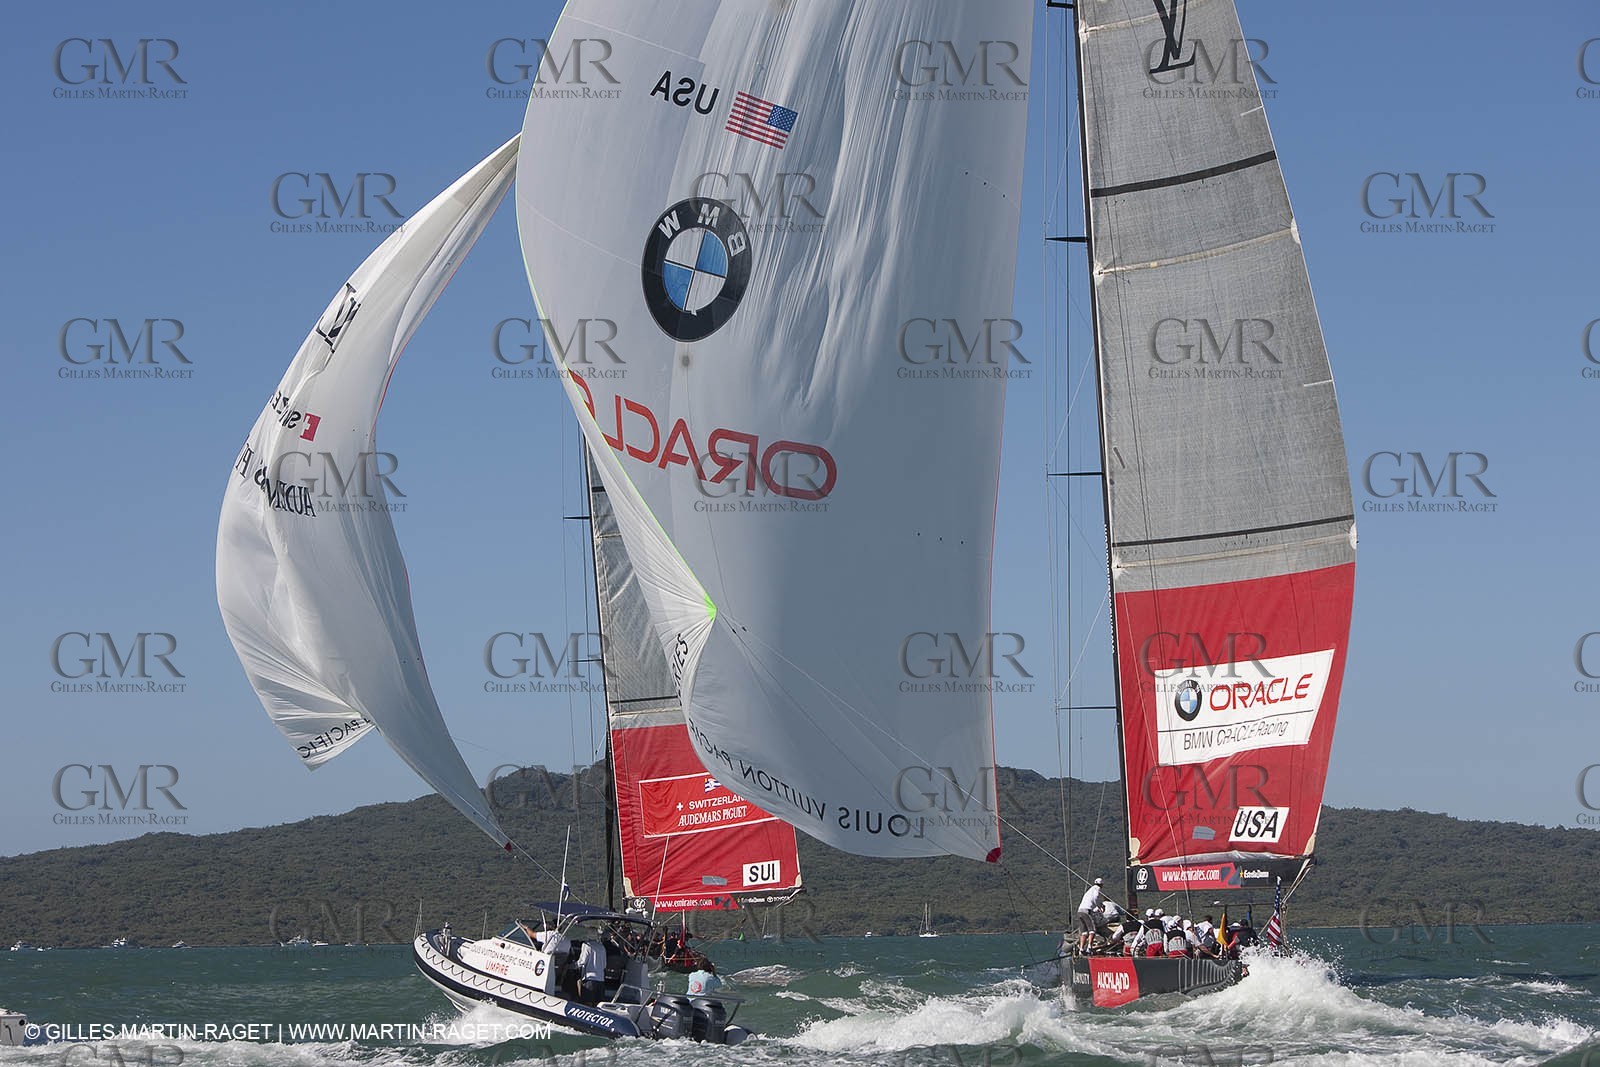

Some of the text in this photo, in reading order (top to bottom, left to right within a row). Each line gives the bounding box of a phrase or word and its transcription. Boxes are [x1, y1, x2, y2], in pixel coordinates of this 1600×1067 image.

[1209, 673, 1313, 711] ORACLE
[1183, 730, 1213, 750] BMW
[1255, 717, 1289, 737] Racing
[689, 794, 746, 810] SWITZERLAN
[678, 805, 748, 827] AUDEMARS PIGUET
[1234, 810, 1279, 838] USA
[748, 863, 776, 883] SUI
[485, 960, 510, 976] UMPIRE
[1097, 971, 1130, 994] AUCKLAND
[567, 1007, 614, 1028] PROTECTOR
